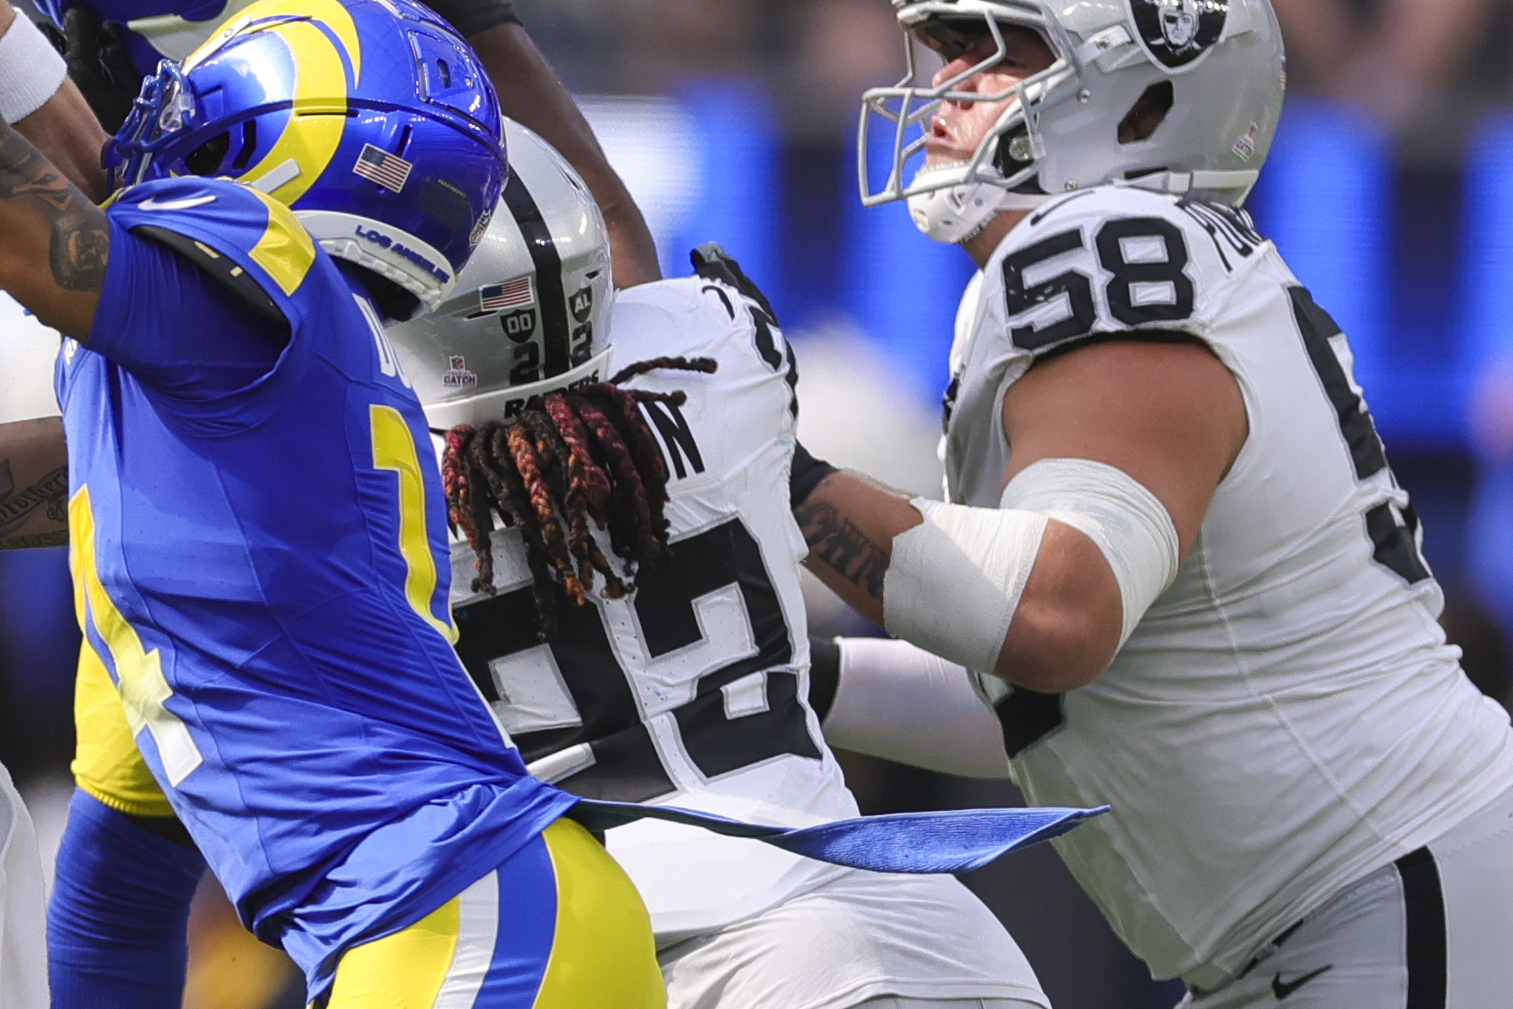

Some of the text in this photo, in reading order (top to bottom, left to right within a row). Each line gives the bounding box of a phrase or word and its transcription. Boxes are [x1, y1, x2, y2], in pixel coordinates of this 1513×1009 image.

[355, 225, 392, 248] LOS
[1001, 216, 1195, 351] 58
[574, 294, 591, 313] AL
[444, 375, 476, 385] CATCH
